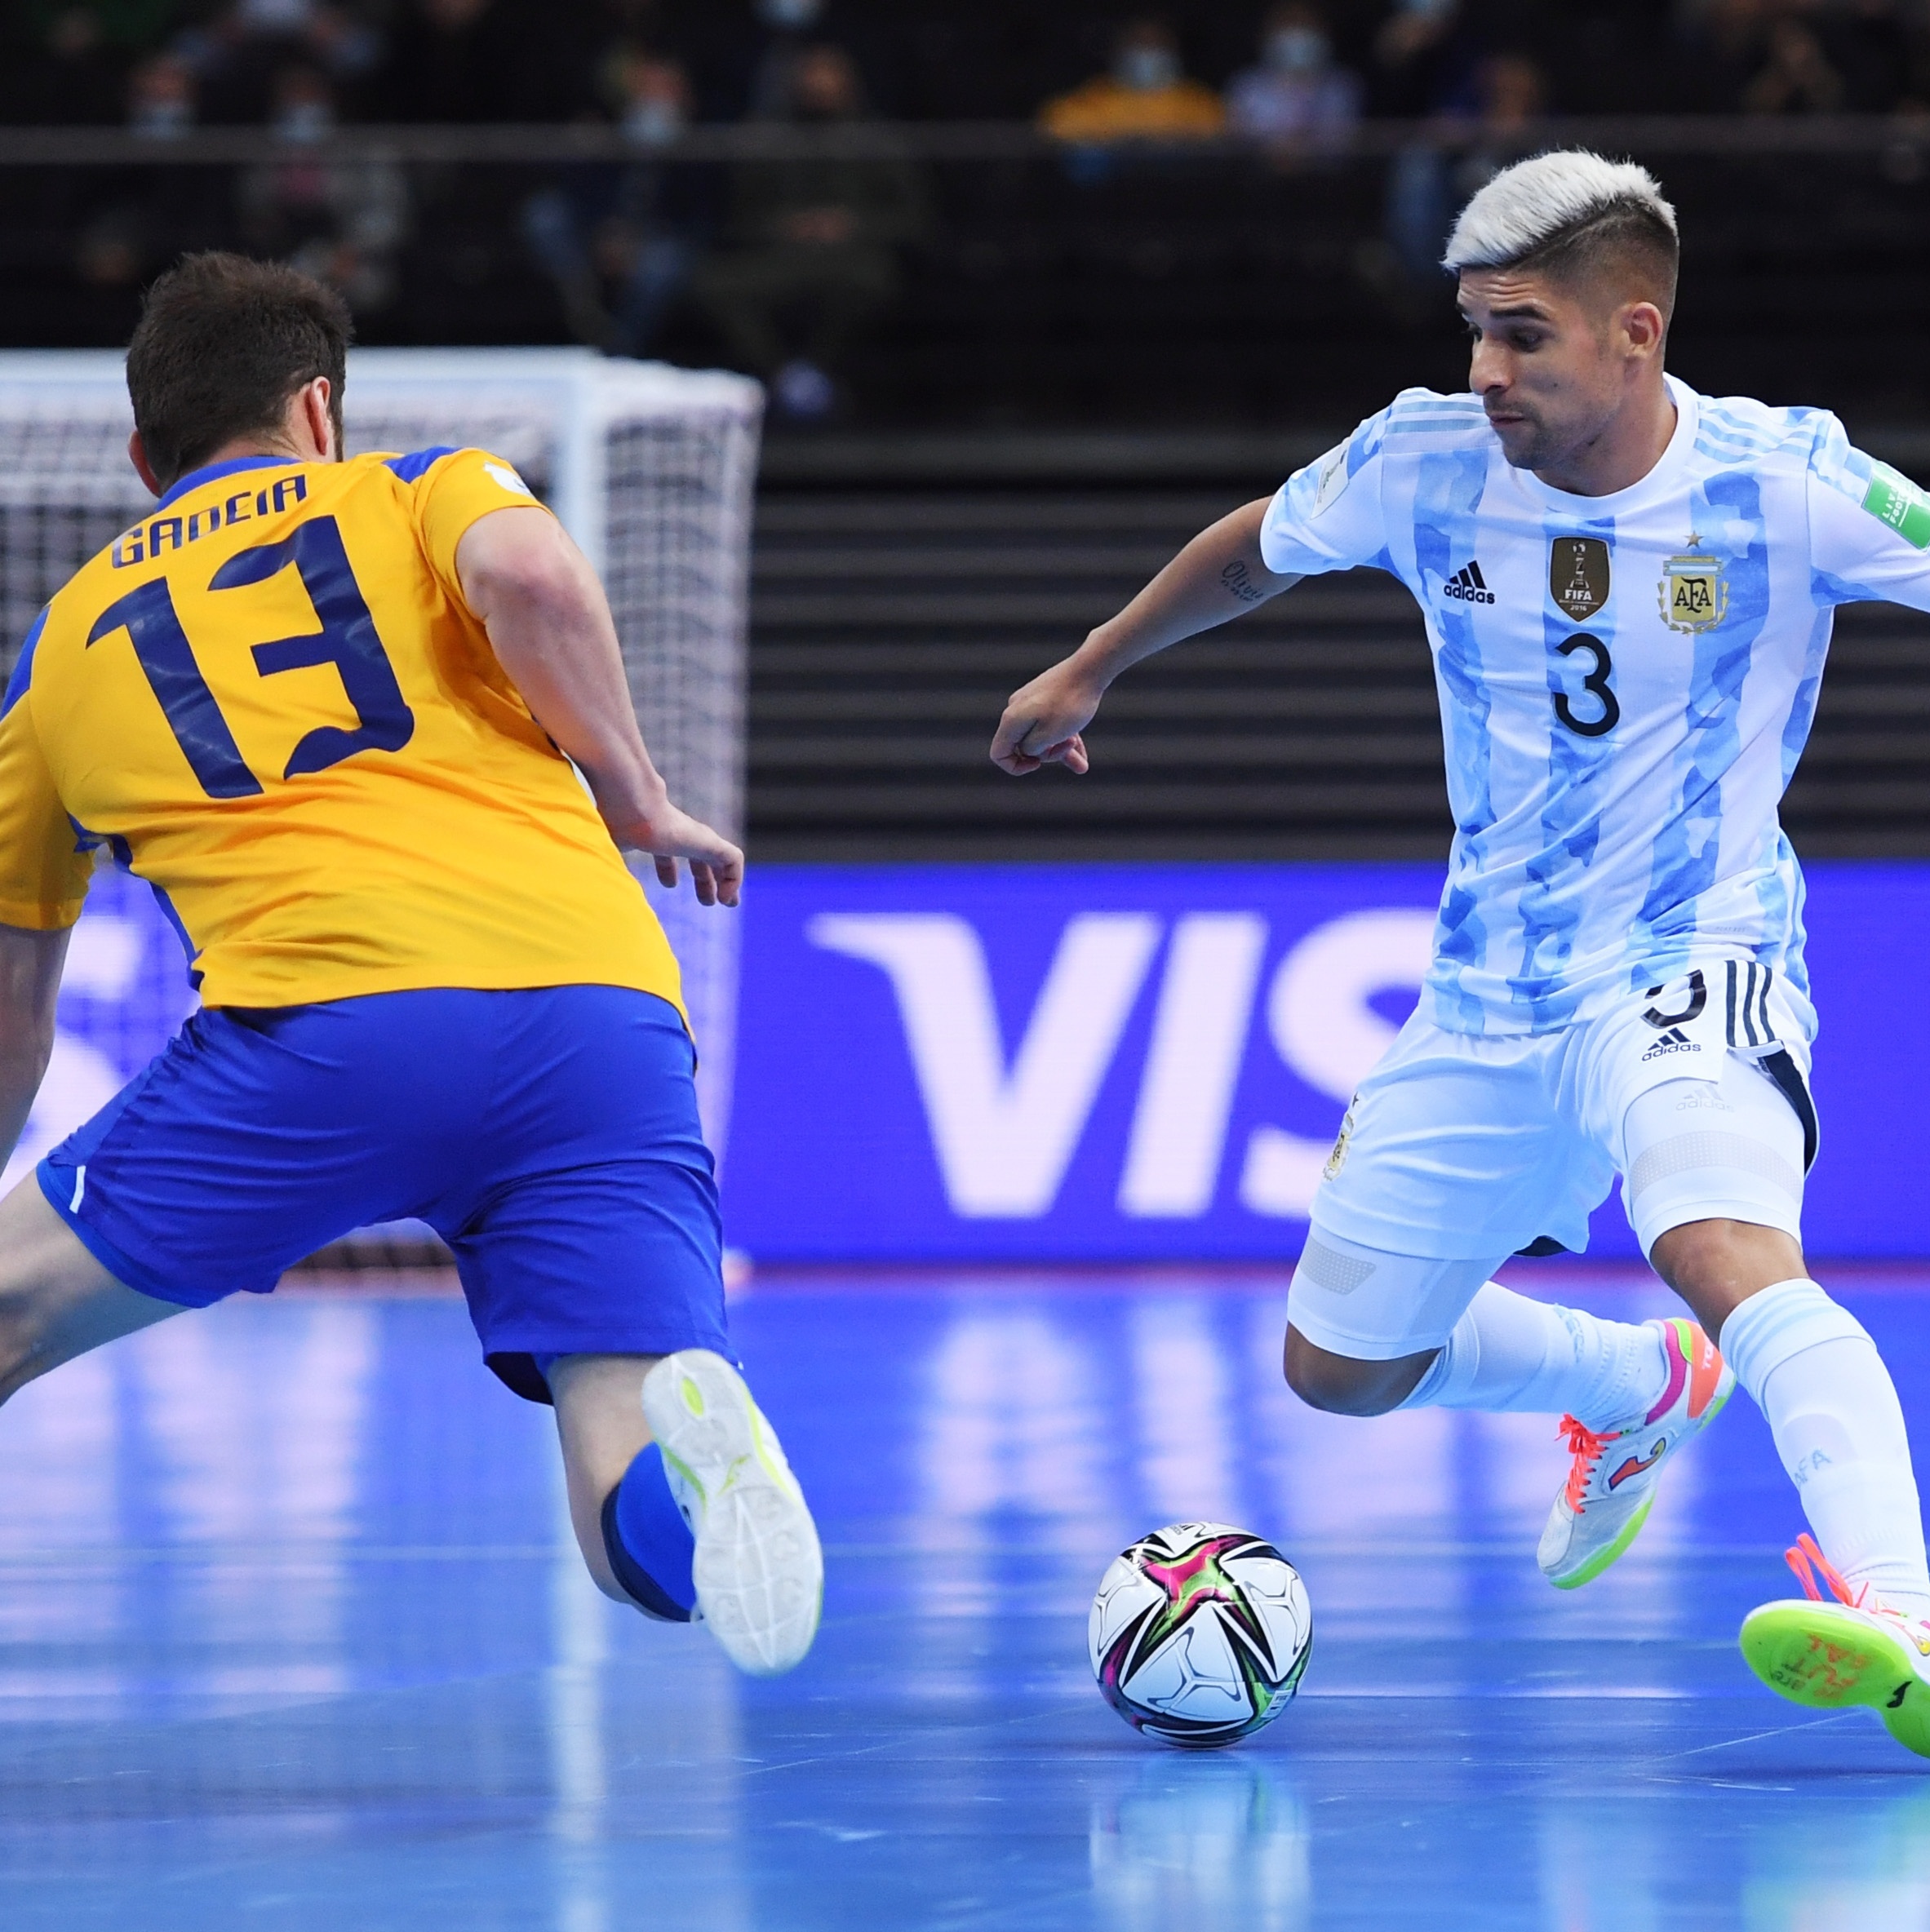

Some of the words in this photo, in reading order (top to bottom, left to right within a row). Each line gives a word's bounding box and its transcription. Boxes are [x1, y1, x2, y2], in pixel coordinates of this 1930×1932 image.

[1444, 582, 1496, 605] adidas
[1564, 589, 1592, 600] FIFA
[1674, 578, 1713, 613] AFA
[85, 514, 415, 799] 13
[1555, 632, 1620, 737] 3
[804, 907, 1446, 1221] VIS
[1641, 1043, 1702, 1061] adidas
[1675, 1098, 1735, 1113] adidas
